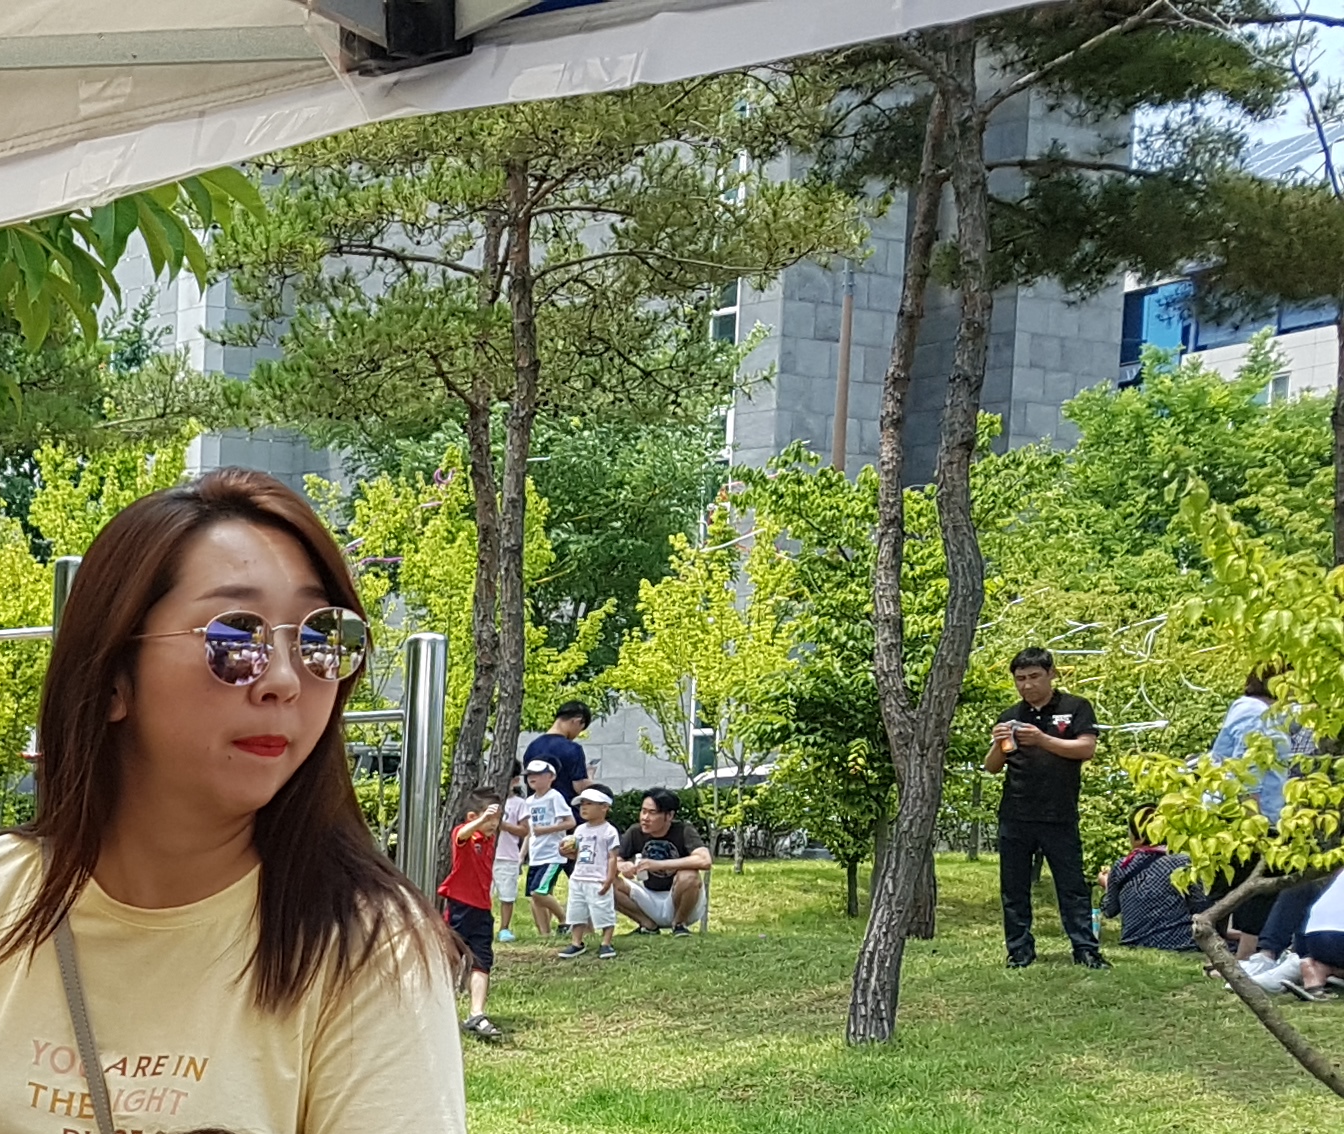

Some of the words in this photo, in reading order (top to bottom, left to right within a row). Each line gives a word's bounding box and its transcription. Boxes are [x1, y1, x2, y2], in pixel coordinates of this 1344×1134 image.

[104, 1055, 169, 1078] ARE
[172, 1055, 209, 1082] IN
[28, 1081, 95, 1120] THE
[112, 1087, 188, 1115] IGHT
